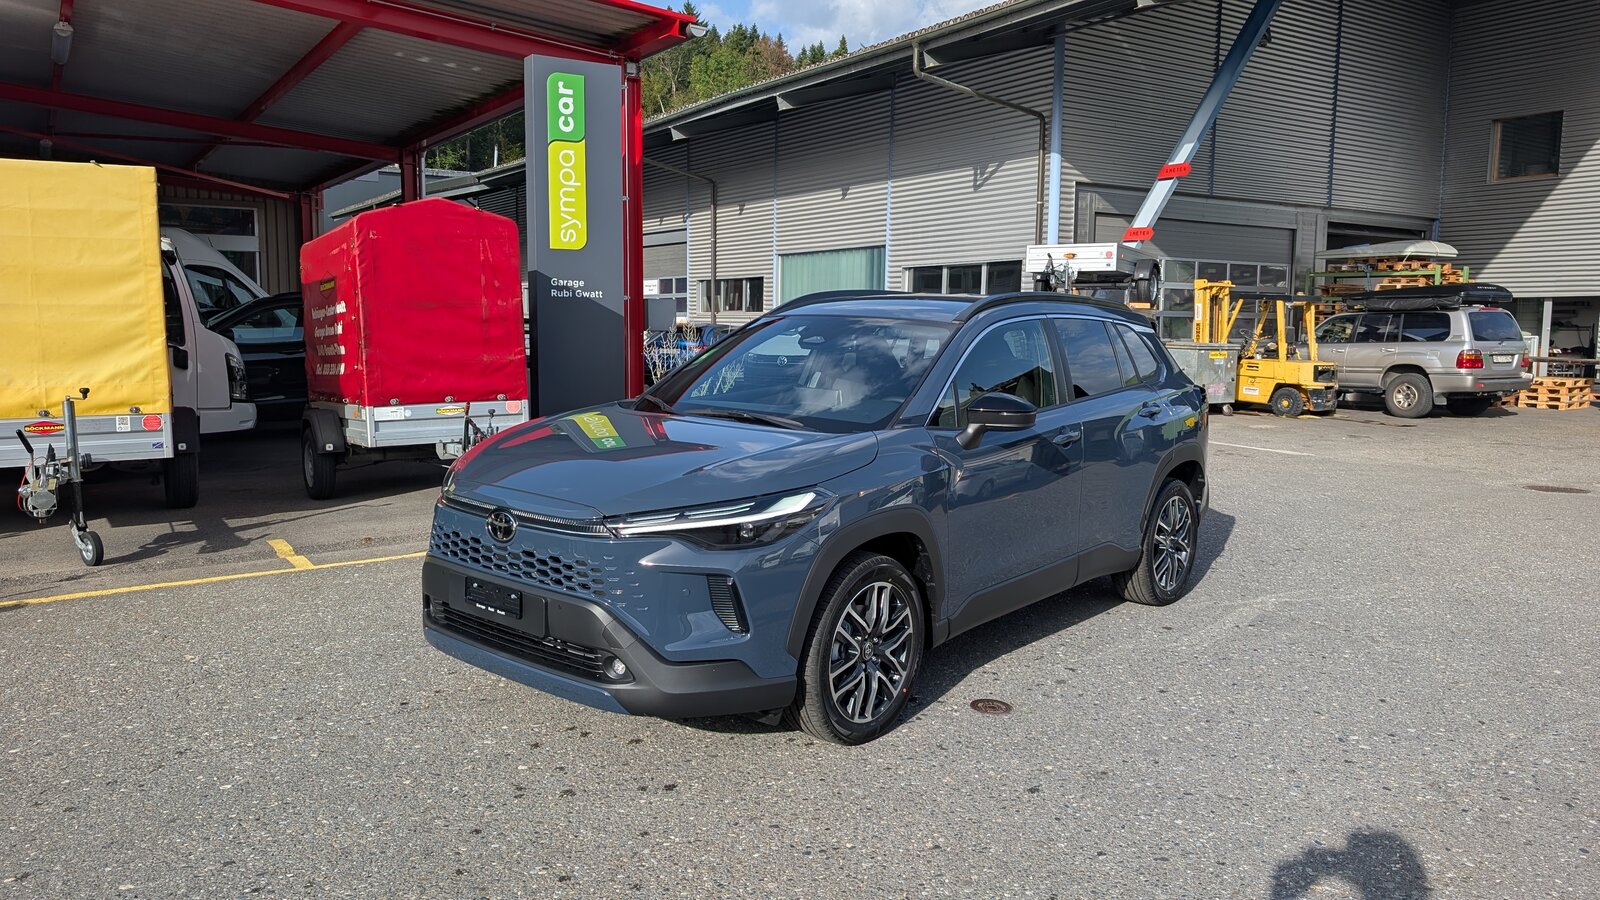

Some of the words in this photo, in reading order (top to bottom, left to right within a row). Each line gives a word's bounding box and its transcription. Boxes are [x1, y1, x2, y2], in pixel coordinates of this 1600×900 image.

[557, 80, 575, 133] car
[559, 149, 581, 243] sympa
[550, 277, 585, 288] Garage
[551, 288, 573, 298] Rubi
[575, 289, 603, 298] Gwatt
